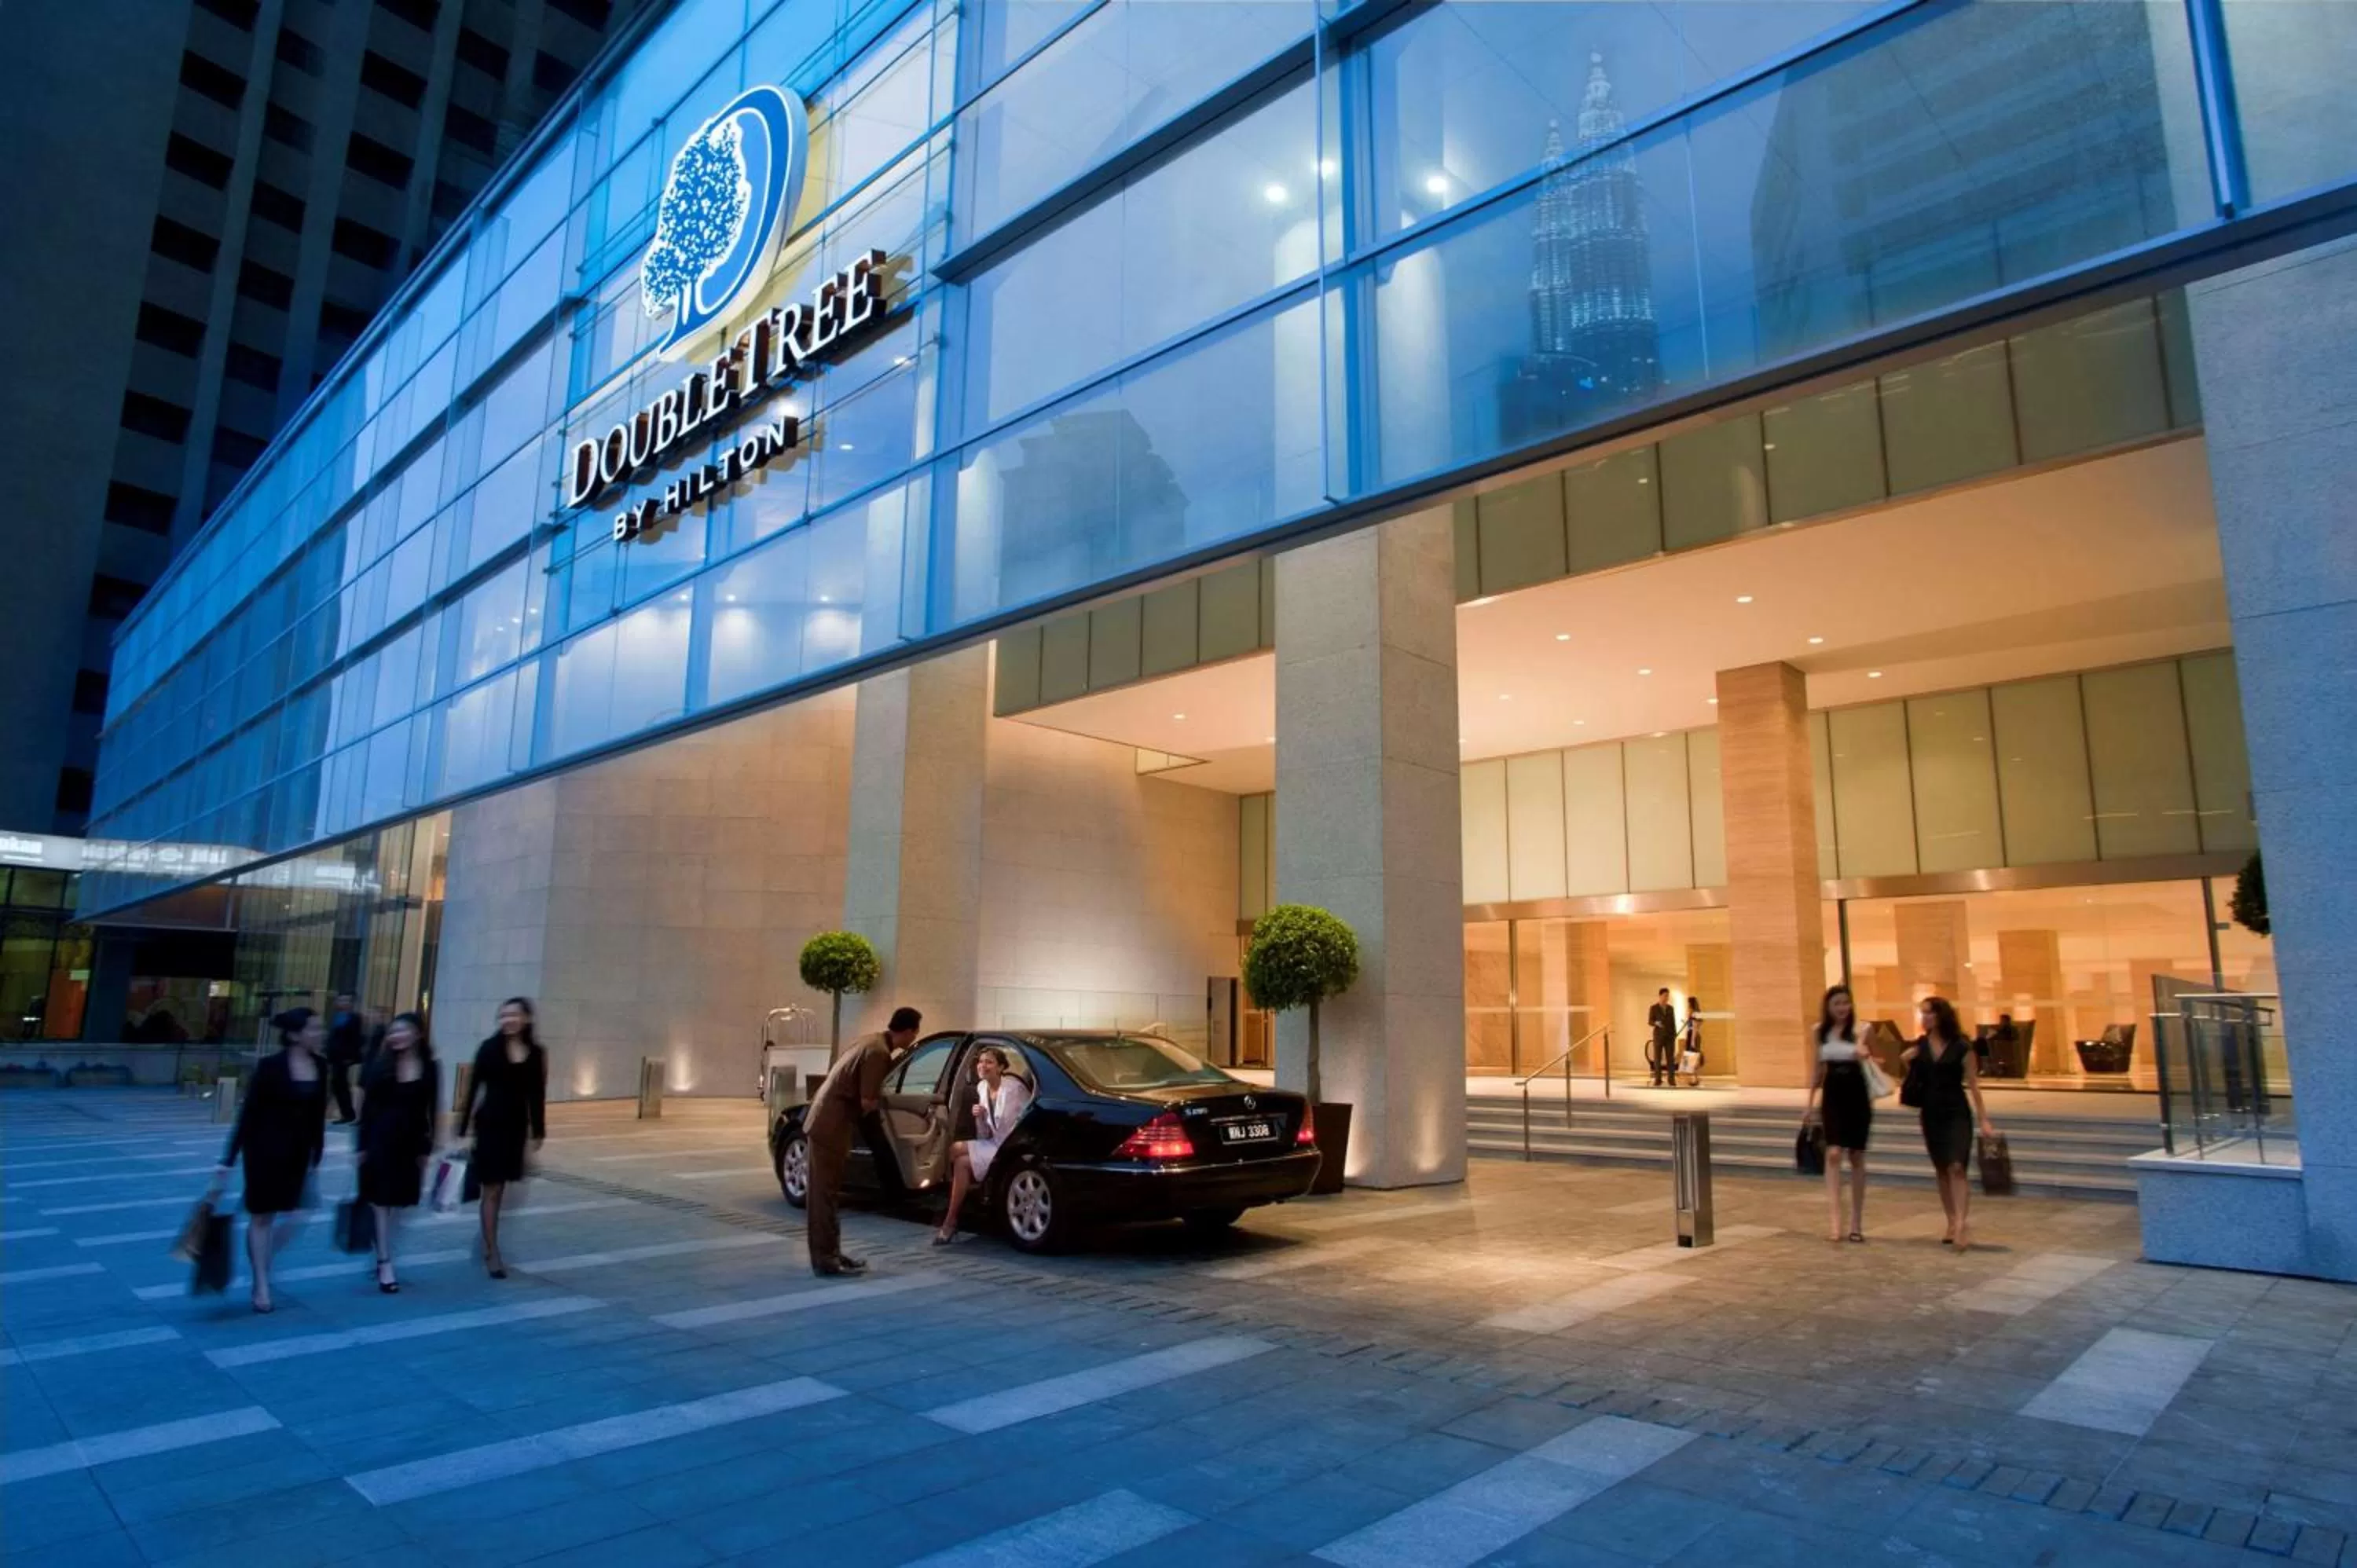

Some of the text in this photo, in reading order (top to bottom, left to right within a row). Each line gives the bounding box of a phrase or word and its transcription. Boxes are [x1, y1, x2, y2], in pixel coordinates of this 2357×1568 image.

[567, 248, 878, 508] DOUBLETREE
[613, 416, 786, 541] BY HILTON
